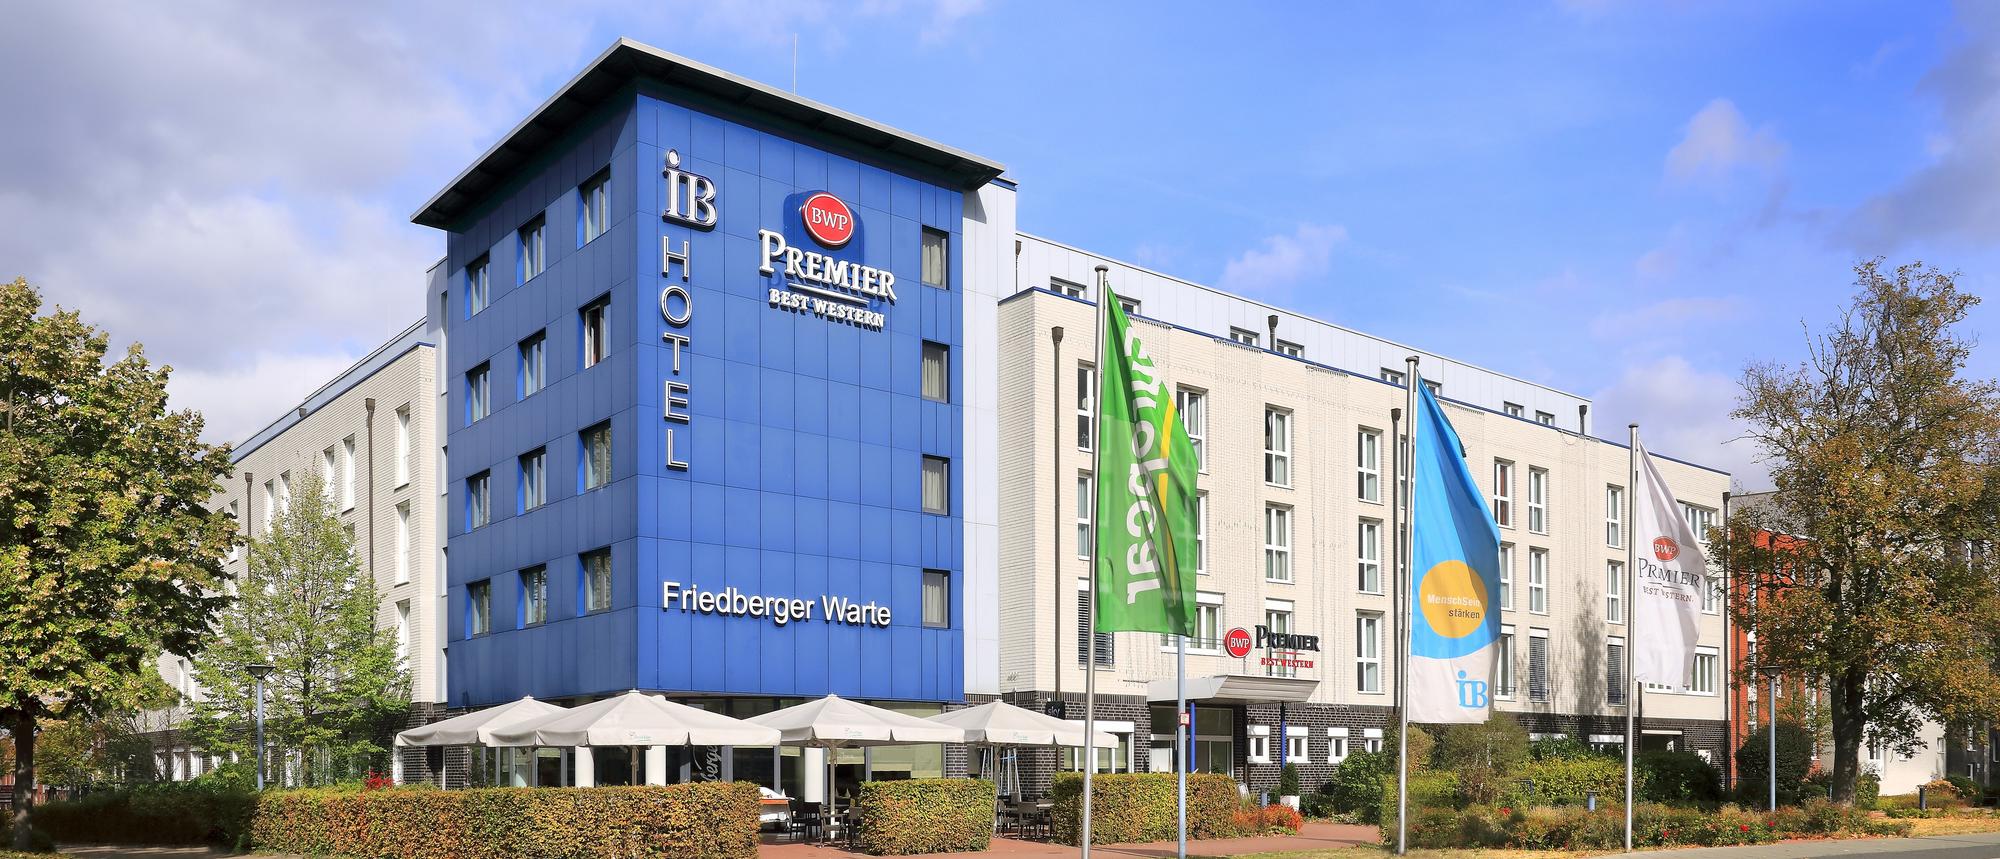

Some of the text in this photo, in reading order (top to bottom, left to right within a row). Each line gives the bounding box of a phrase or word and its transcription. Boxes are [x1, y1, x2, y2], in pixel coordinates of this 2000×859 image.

[811, 207, 848, 231] BWP
[759, 229, 897, 300] PREMIER
[769, 288, 885, 328] BEST WESTERN
[660, 235, 692, 471] HOTEL
[1654, 543, 1677, 555] BWP
[663, 581, 891, 626] Friedberger Warte
[1427, 593, 1480, 607] MenschSein
[1448, 608, 1480, 619] stärken
[1230, 637, 1250, 649] BWP
[1255, 624, 1321, 652] PREMIER
[1261, 657, 1314, 669] BEST WESTERN
[1047, 705, 1060, 717] sky
